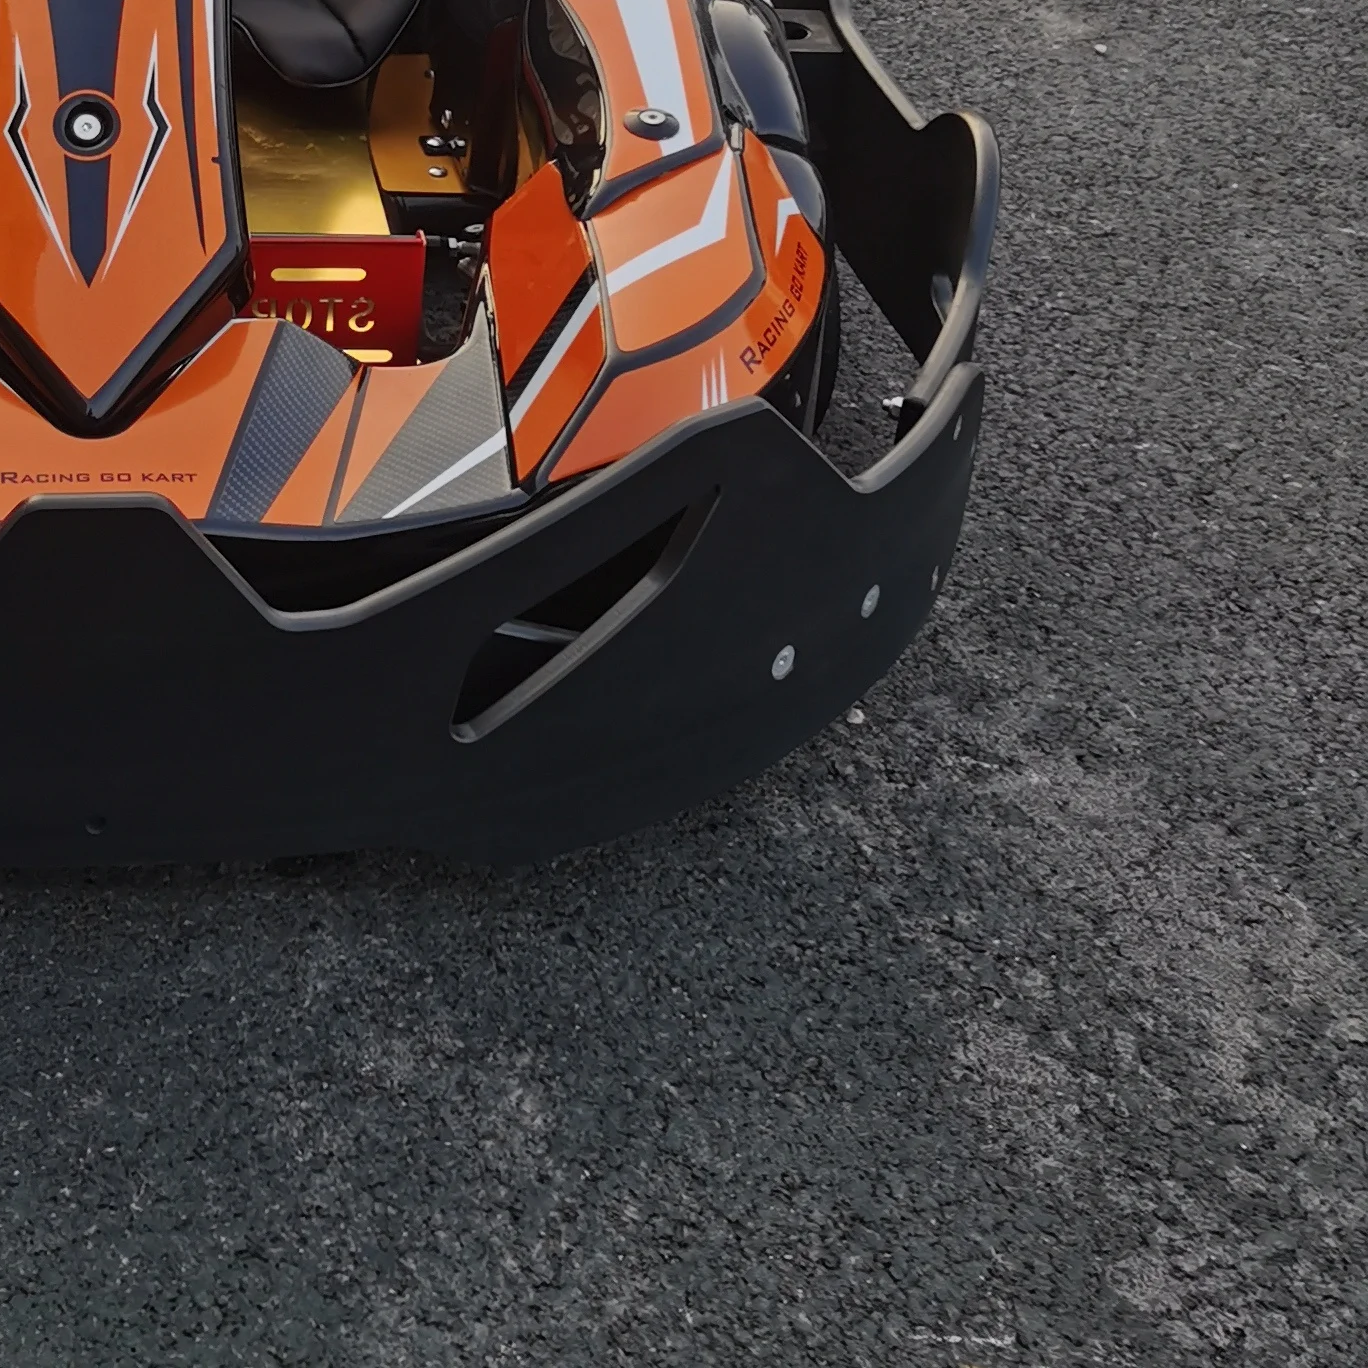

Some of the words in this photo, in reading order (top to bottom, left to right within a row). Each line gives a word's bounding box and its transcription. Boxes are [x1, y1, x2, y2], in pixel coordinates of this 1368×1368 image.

[793, 241, 808, 280] KART
[789, 275, 804, 302] GO
[100, 472, 132, 482] GO
[141, 472, 198, 483] KART
